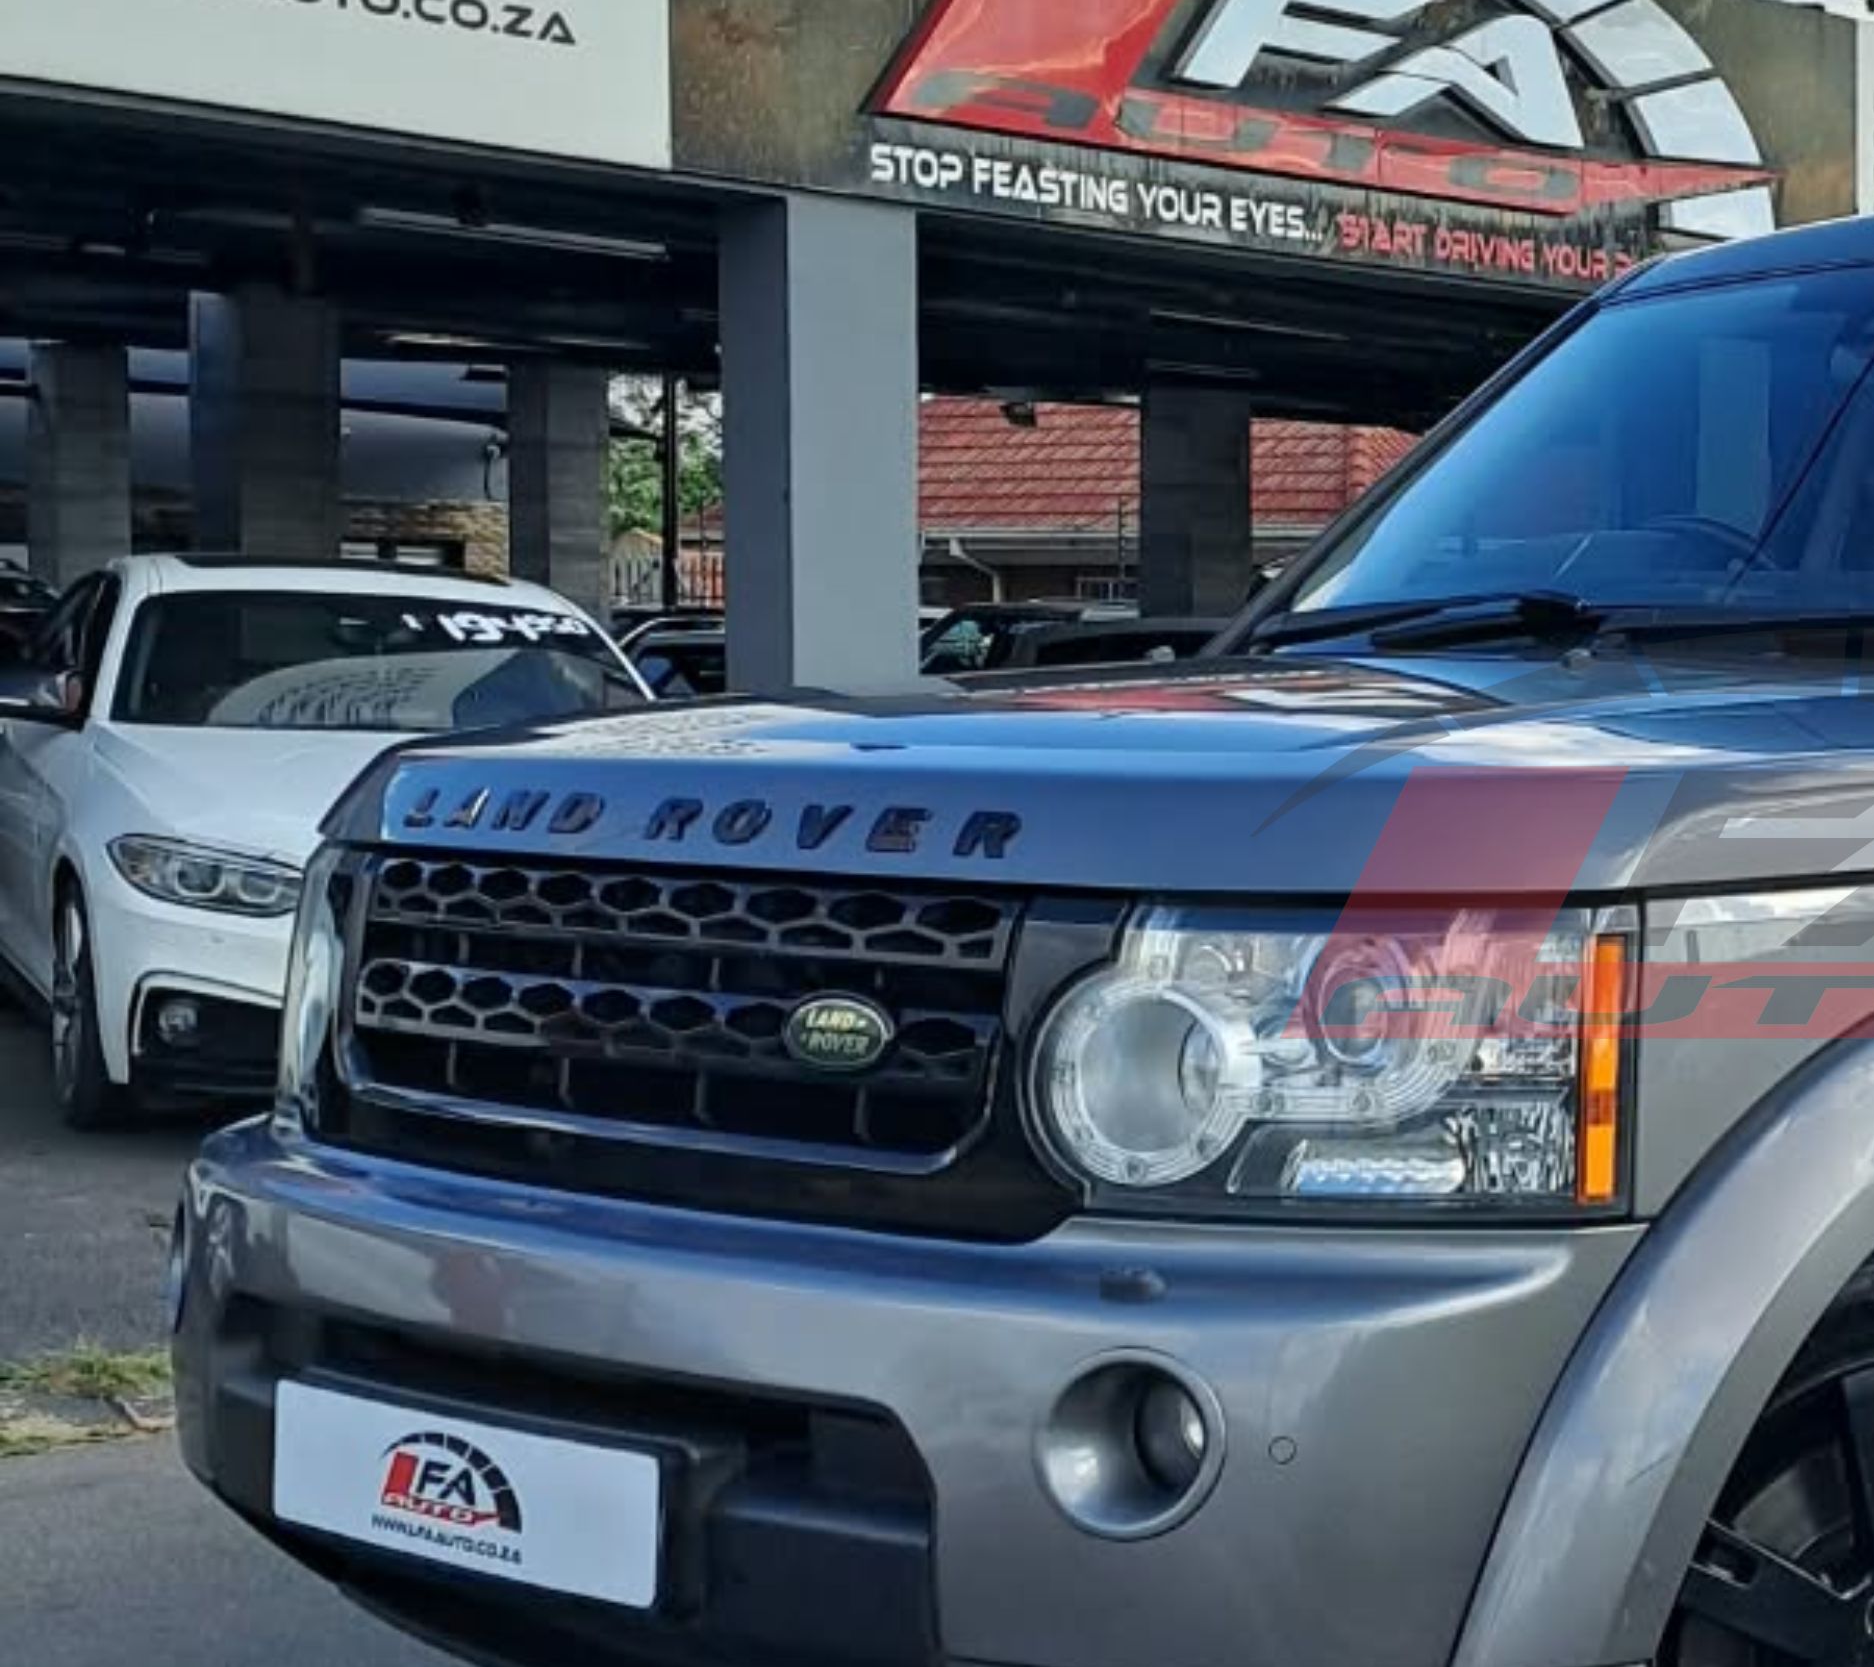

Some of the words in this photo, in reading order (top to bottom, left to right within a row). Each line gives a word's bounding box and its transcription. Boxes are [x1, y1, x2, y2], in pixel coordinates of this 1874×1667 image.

[907, 69, 1581, 201] AUTO
[870, 142, 964, 190] STOP
[972, 157, 1131, 215] FEASTING
[1136, 181, 1223, 229] YOUR
[1230, 198, 1323, 242] EYES...
[1338, 213, 1428, 256] START
[1435, 228, 1535, 274] DRIVING
[1541, 242, 1607, 279] YOUR
[403, 787, 607, 834] LAND
[643, 797, 1022, 859] ROVER
